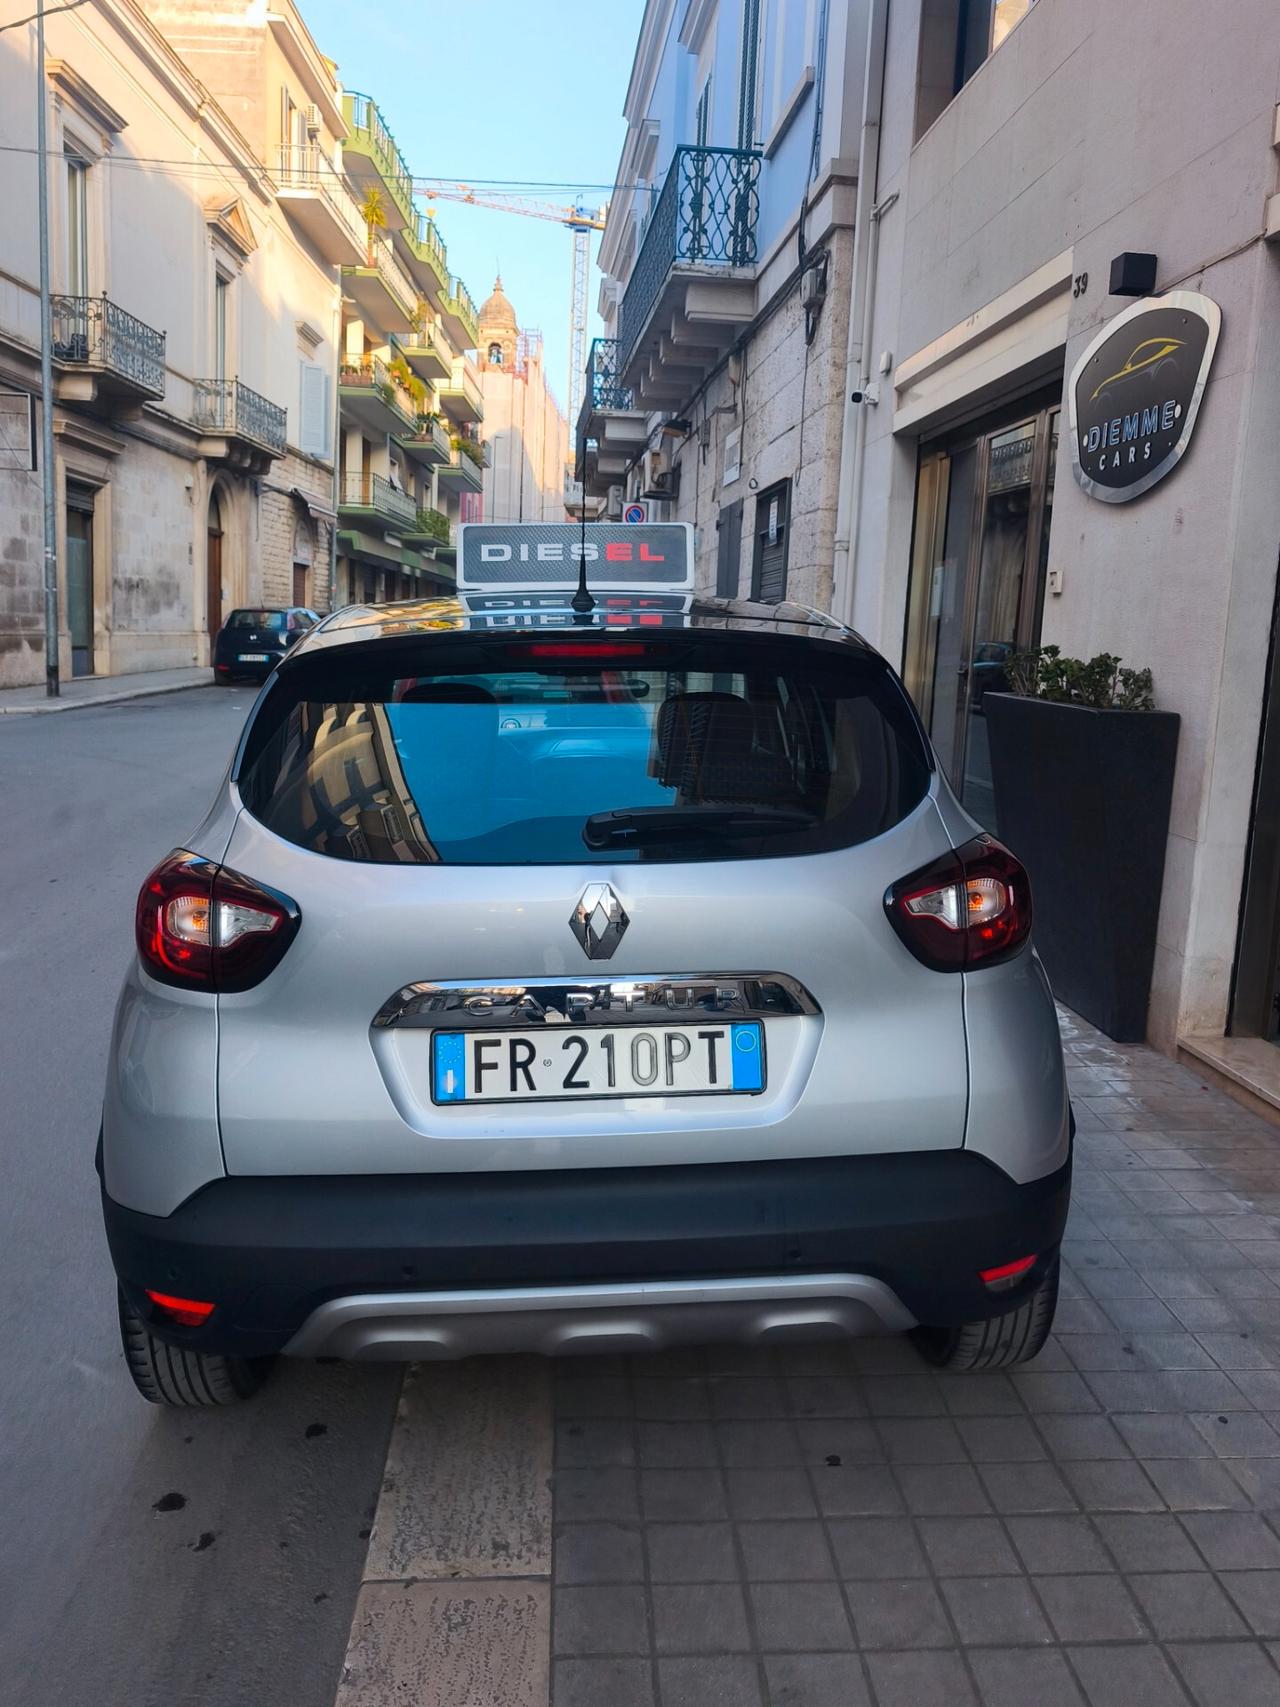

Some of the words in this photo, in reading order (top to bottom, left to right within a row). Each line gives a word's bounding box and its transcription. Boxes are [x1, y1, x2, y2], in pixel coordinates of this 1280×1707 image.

[1073, 272, 1089, 298] 39
[1087, 399, 1177, 453] DIEMME
[1098, 442, 1152, 471] CARS
[480, 543, 665, 562] DIESEL
[463, 987, 745, 1018] CAPTUR
